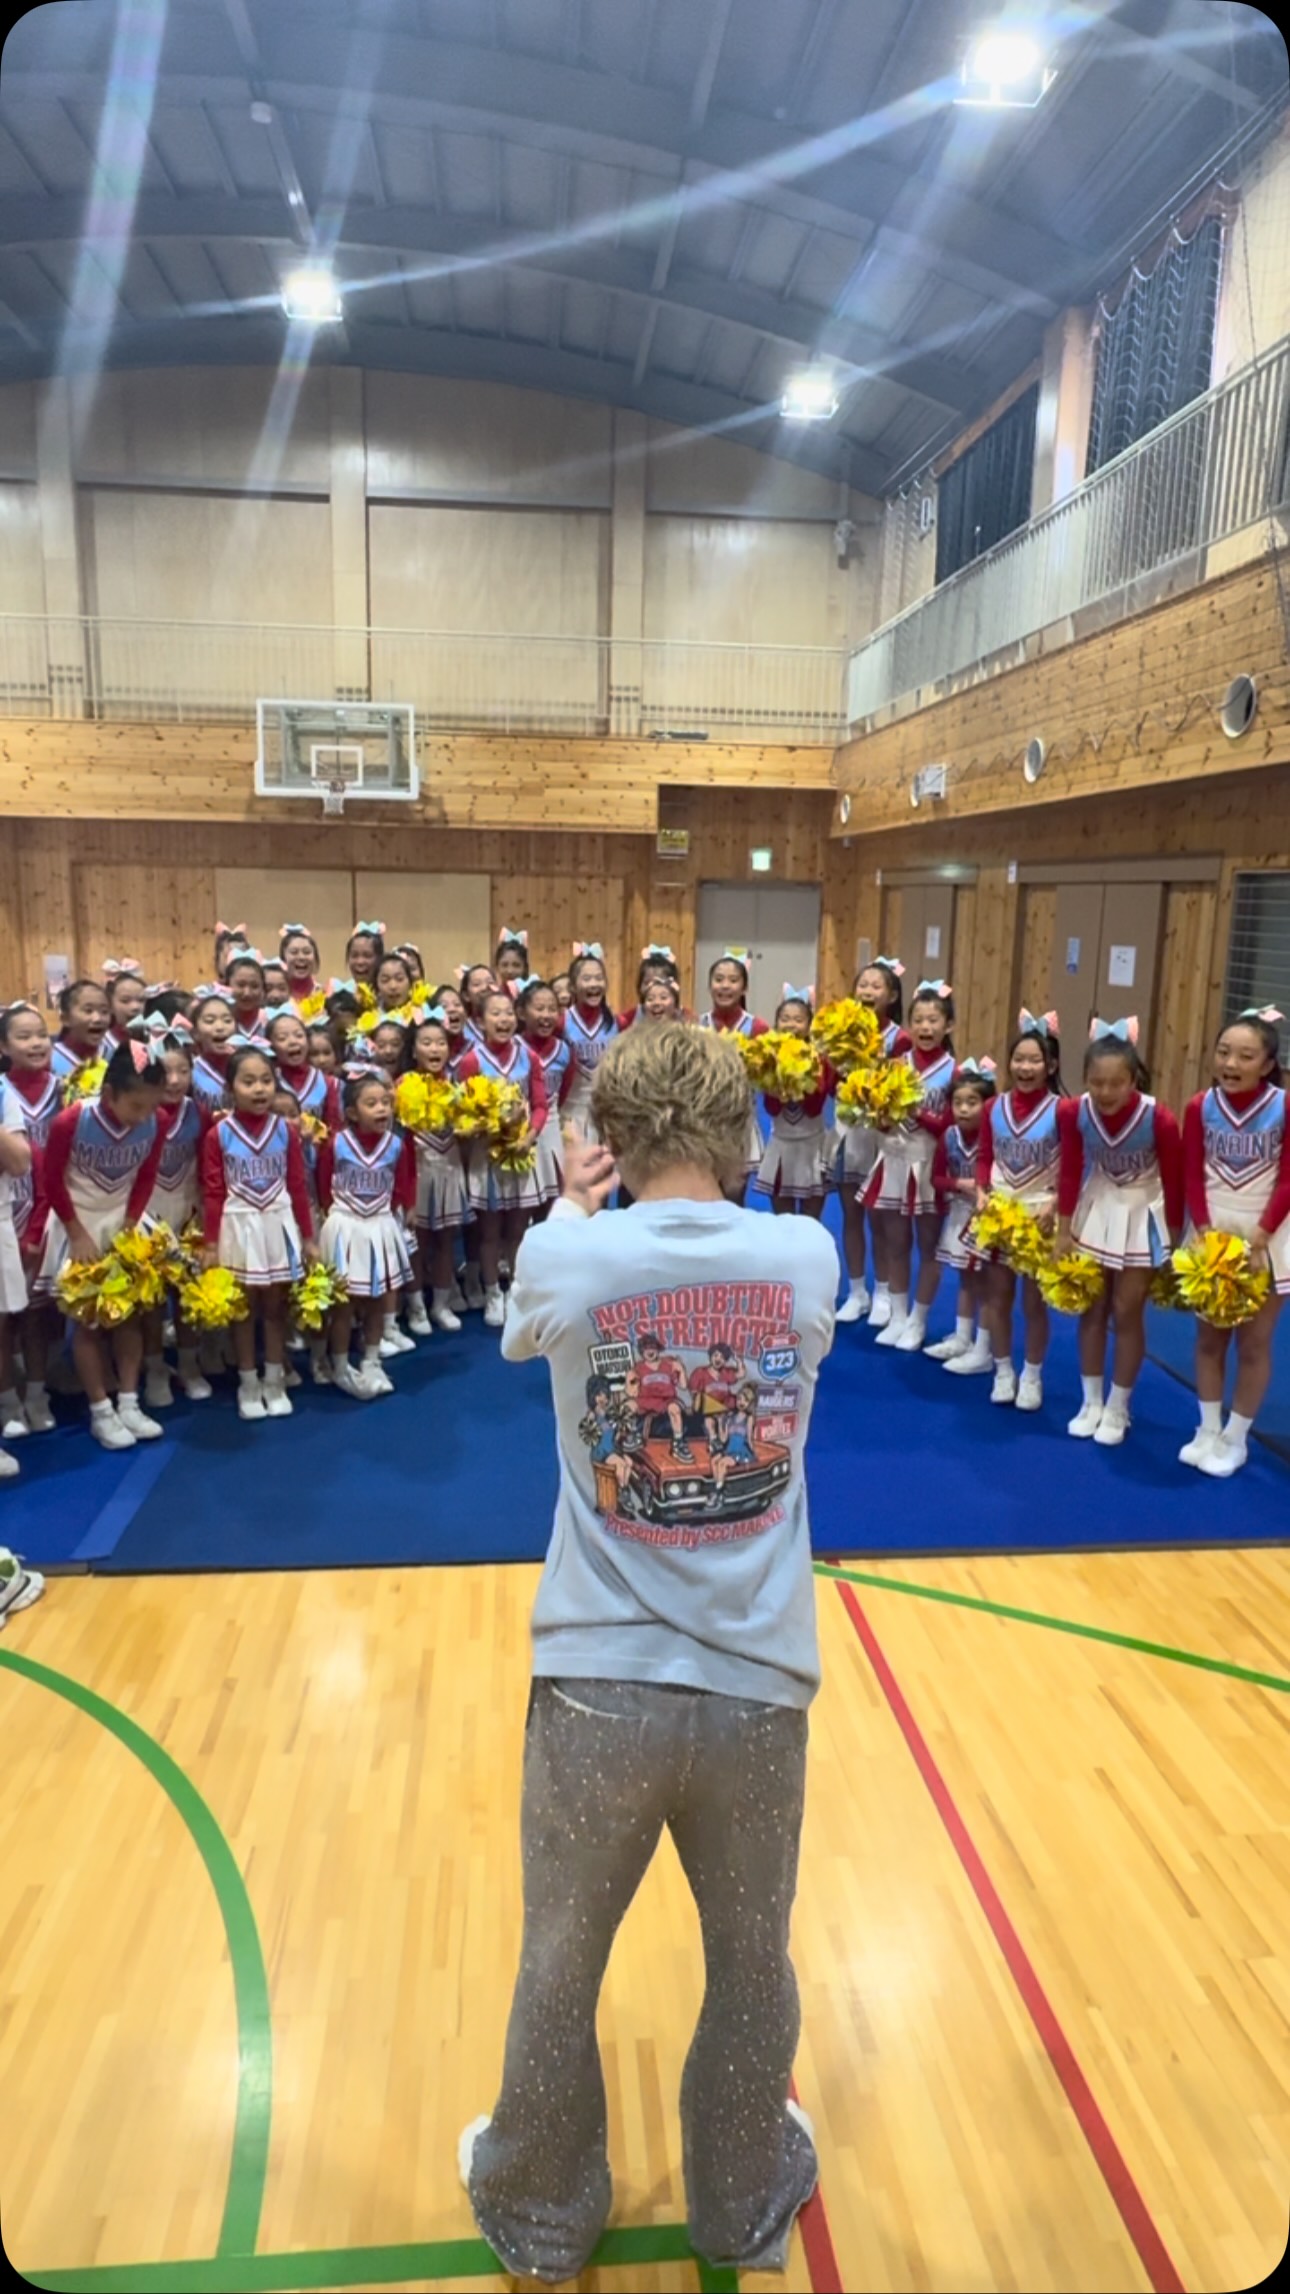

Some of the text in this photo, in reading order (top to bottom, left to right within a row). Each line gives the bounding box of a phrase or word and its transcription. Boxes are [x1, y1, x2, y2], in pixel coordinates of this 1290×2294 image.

[224, 1150, 288, 1184] MARIN
[592, 1282, 795, 1330] NOT DOUBTING
[593, 1345, 629, 1363] OTOKO
[766, 1350, 794, 1372] 323
[604, 1512, 679, 1547] Presented
[681, 1524, 700, 1552] by
